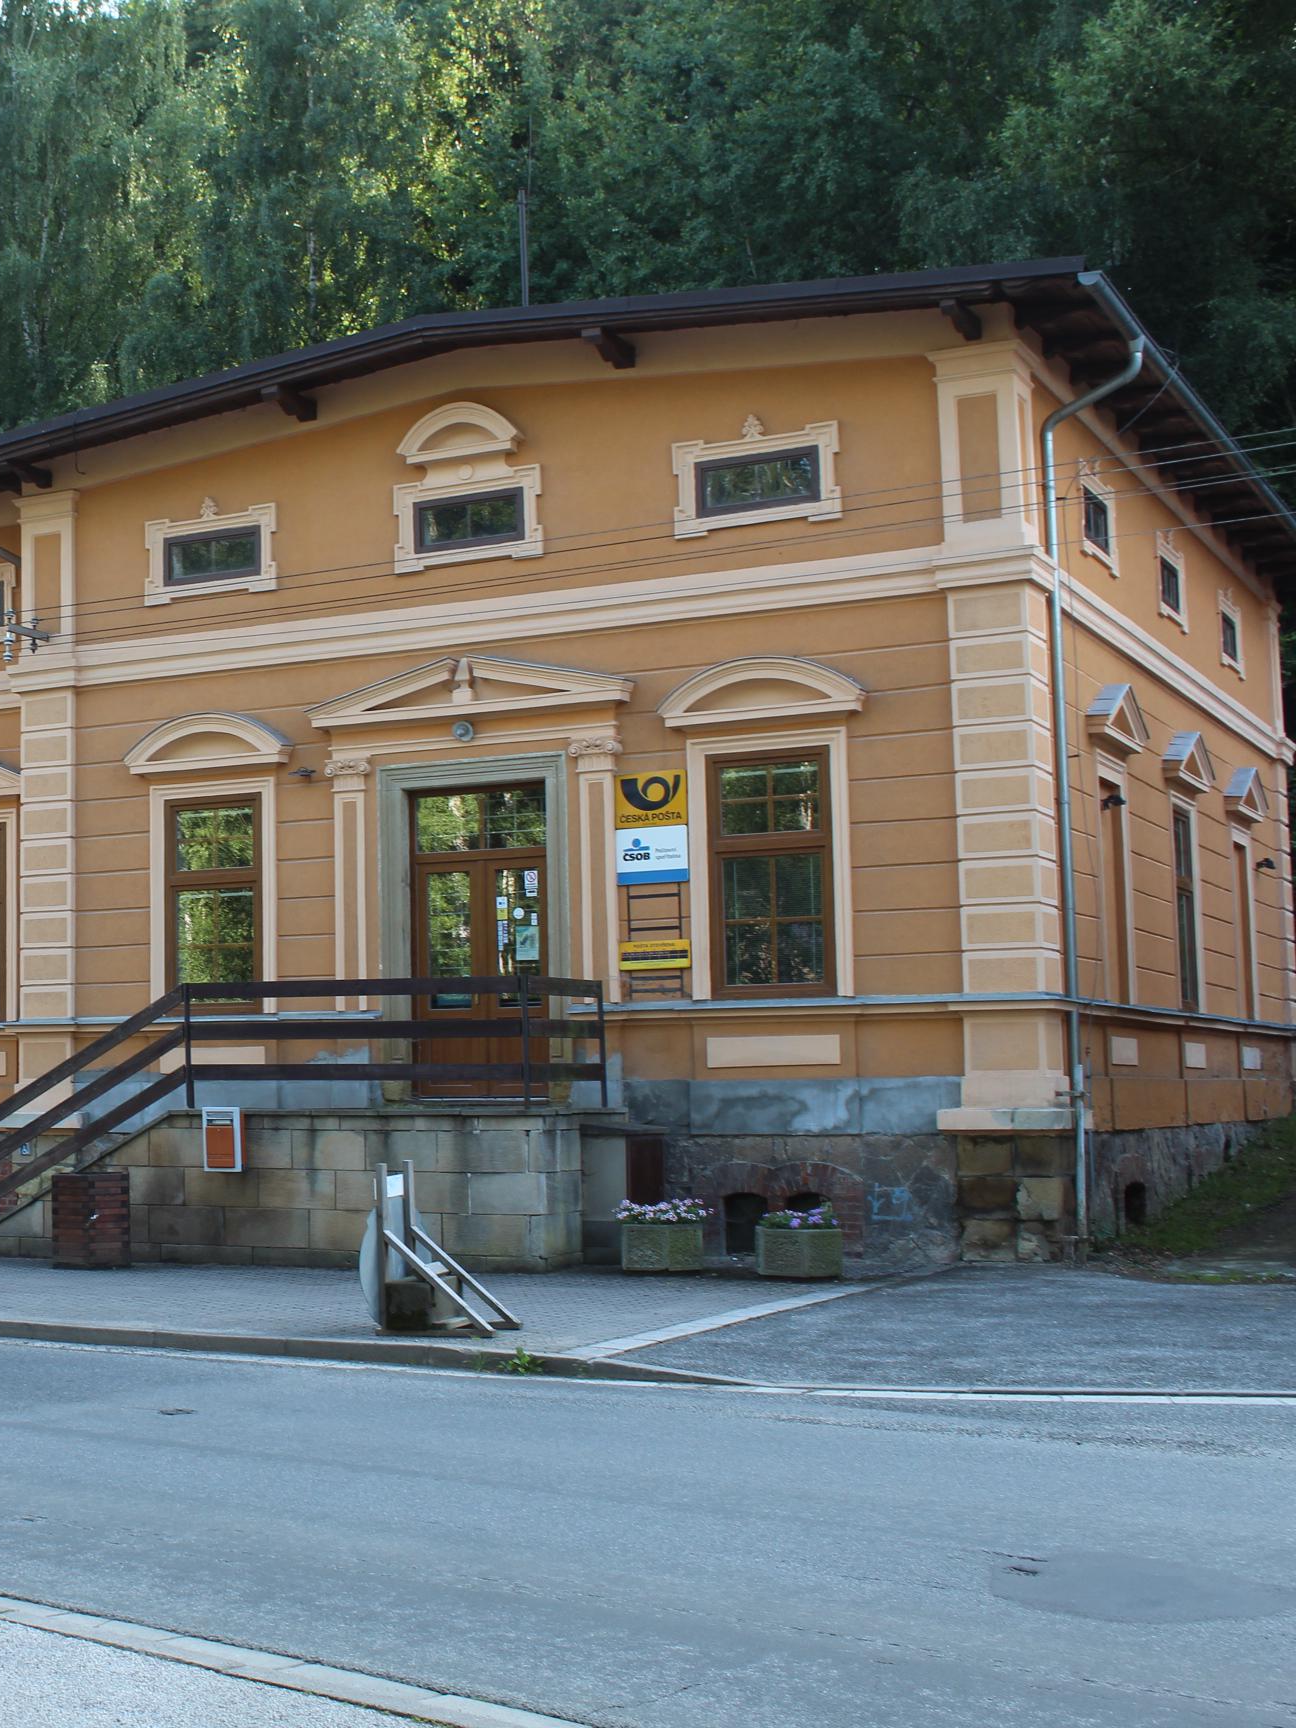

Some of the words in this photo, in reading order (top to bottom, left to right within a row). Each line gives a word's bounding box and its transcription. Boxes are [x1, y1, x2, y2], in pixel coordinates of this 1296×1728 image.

[620, 811, 650, 824] ČESKÁ
[651, 810, 682, 821] POŠTA
[623, 852, 650, 862] ČSOB
